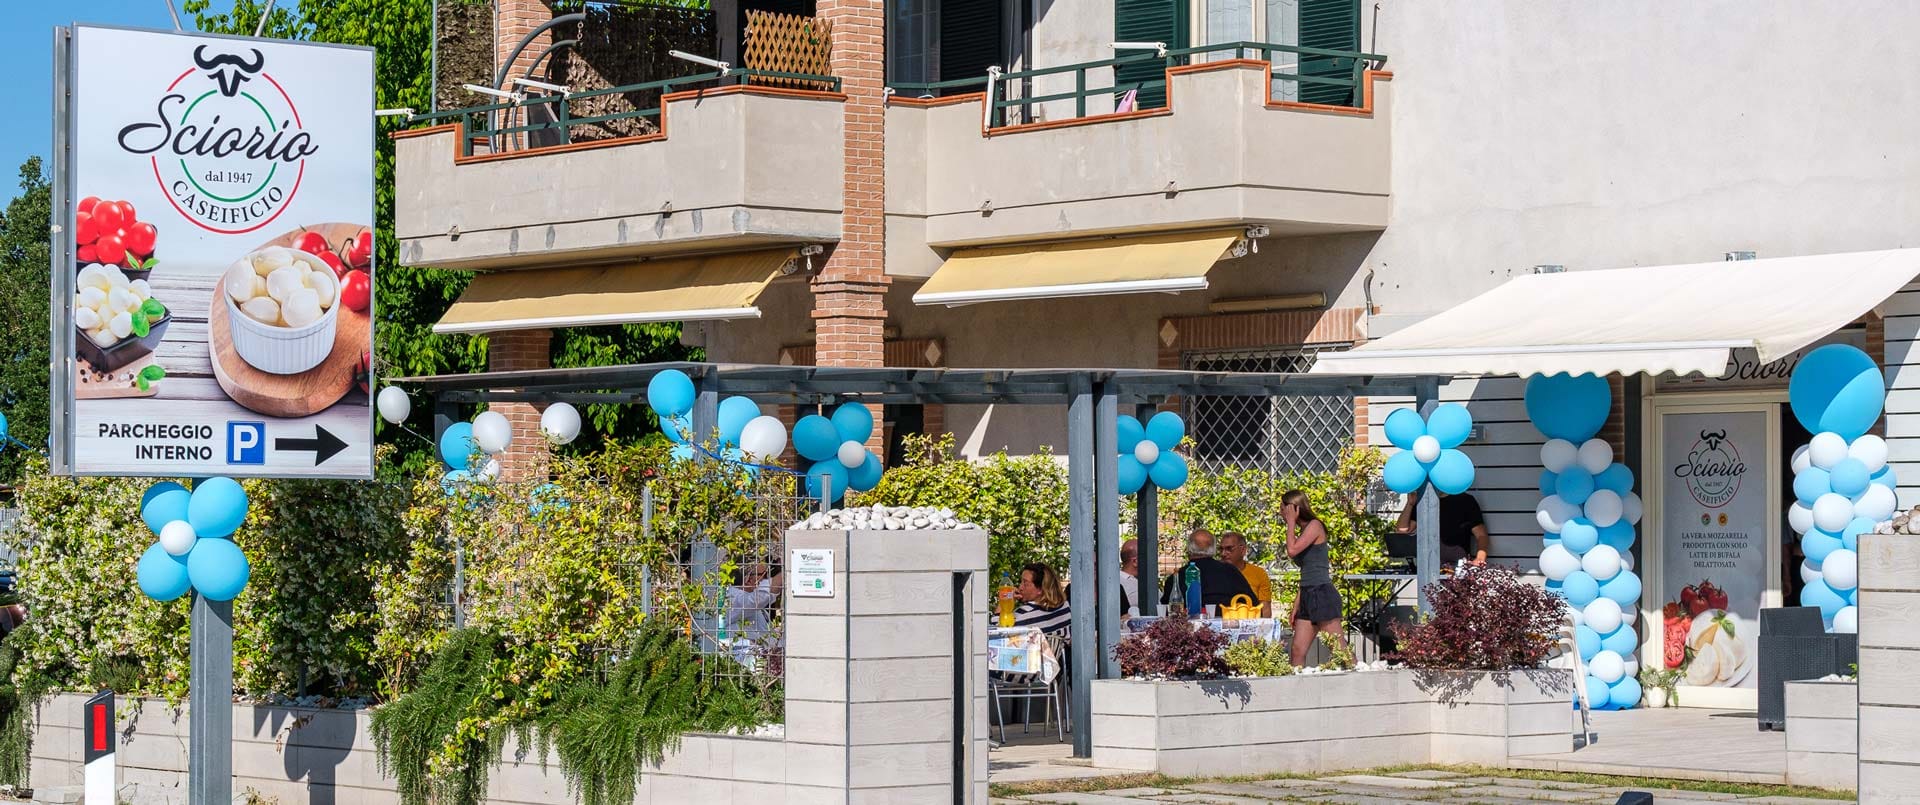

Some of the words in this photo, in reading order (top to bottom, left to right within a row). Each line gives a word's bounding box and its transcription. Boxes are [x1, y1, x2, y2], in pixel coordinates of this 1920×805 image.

[117, 94, 319, 162] Sciorio
[205, 171, 223, 182] dal
[227, 171, 253, 184] 1947
[173, 180, 283, 223] CASEIFICIO
[1715, 347, 1800, 381] Sciori
[98, 423, 213, 439] PARCHEGGIO
[233, 424, 259, 461] P
[135, 444, 213, 460] INTERNO
[1674, 450, 1748, 478] Sciorio
[1693, 486, 1734, 505] CASEIFICIO
[1689, 551, 1708, 559] LATTE
[1709, 551, 1716, 559] DI
[1717, 551, 1741, 559] BUFALA
